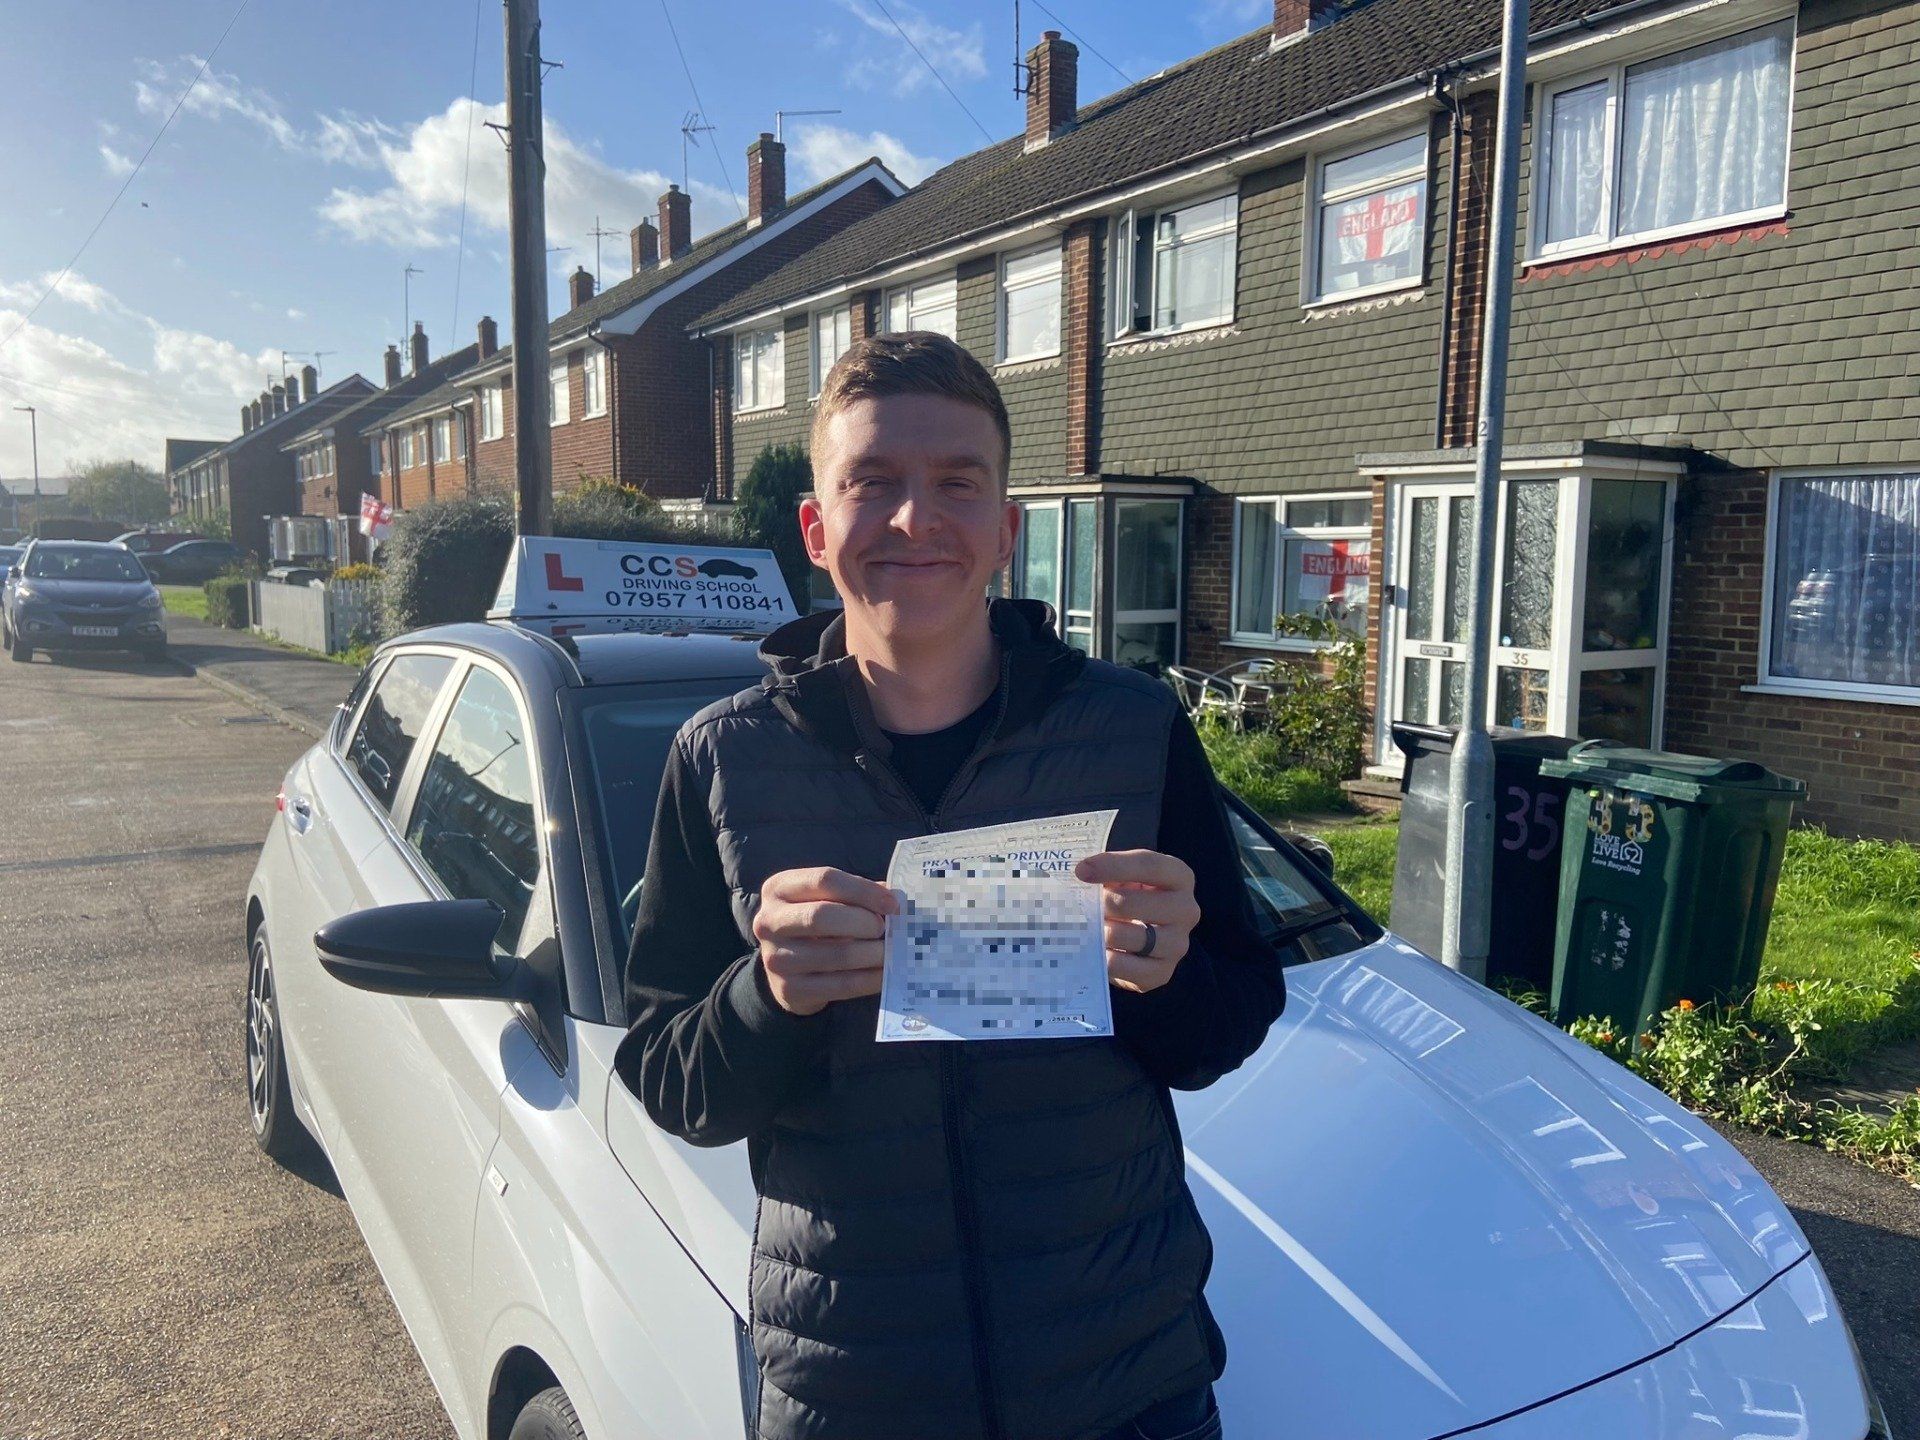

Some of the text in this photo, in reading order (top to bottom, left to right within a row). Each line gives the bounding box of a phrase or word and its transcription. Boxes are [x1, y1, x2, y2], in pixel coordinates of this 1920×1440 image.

[1342, 200, 1410, 235] ENGLAND
[544, 553, 584, 592] L
[620, 554, 698, 578] CCS
[1308, 555, 1370, 575] ENGLAND
[622, 578, 762, 594] DRIVING SCHOOL
[605, 591, 784, 612] 07957 110841
[1512, 652, 1529, 666] 35
[1502, 786, 1559, 862] 35
[1594, 832, 1621, 845] LOVE
[1007, 848, 1073, 862] DRIVING
[1592, 844, 1620, 859] LIVE
[1591, 857, 1641, 876] Love Recycling
